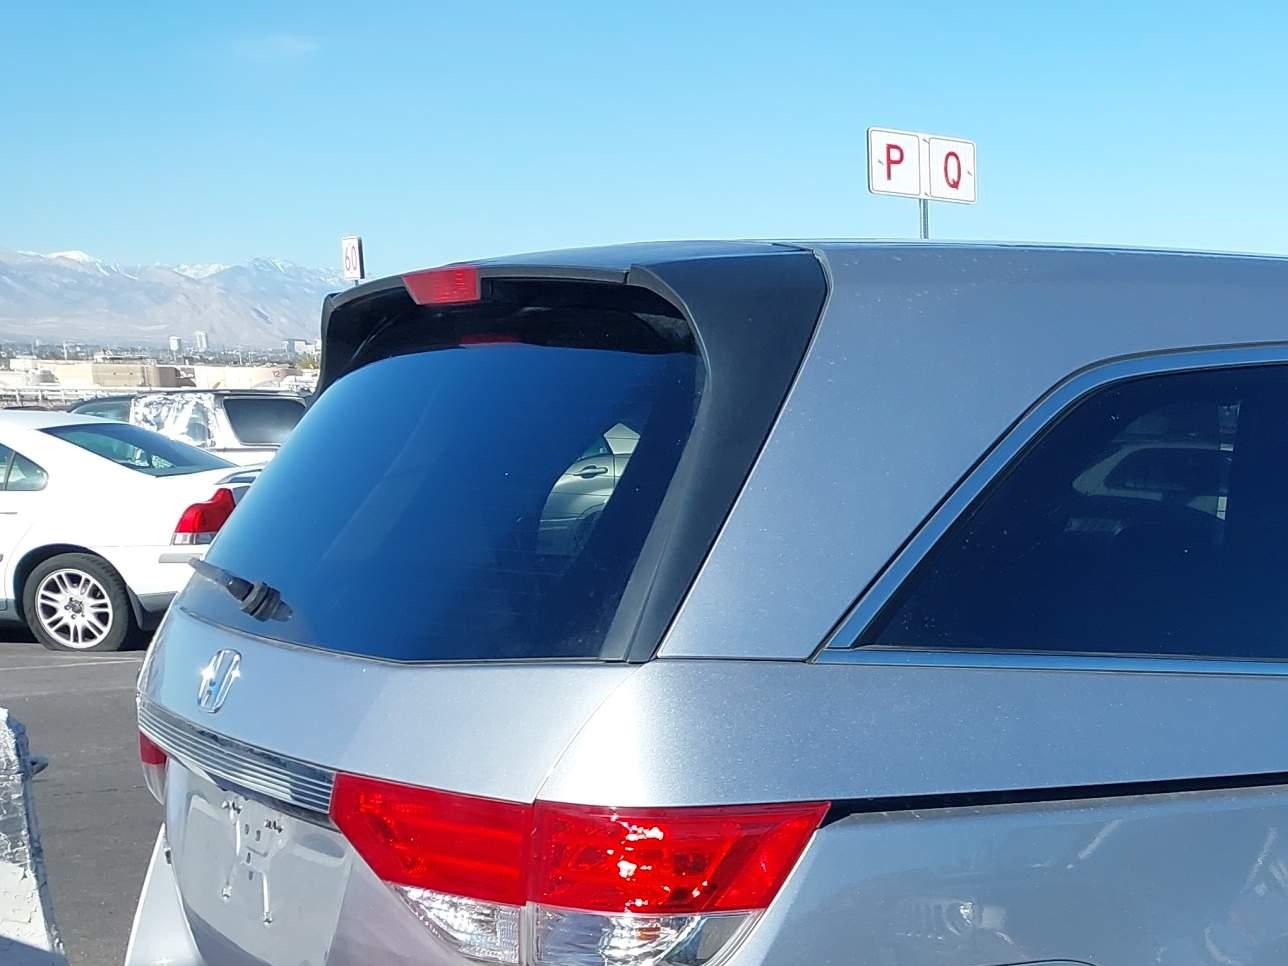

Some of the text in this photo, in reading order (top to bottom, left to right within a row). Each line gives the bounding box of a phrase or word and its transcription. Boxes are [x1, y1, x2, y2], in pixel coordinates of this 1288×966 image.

[885, 143, 962, 190] P Q
[344, 244, 358, 271] 60
